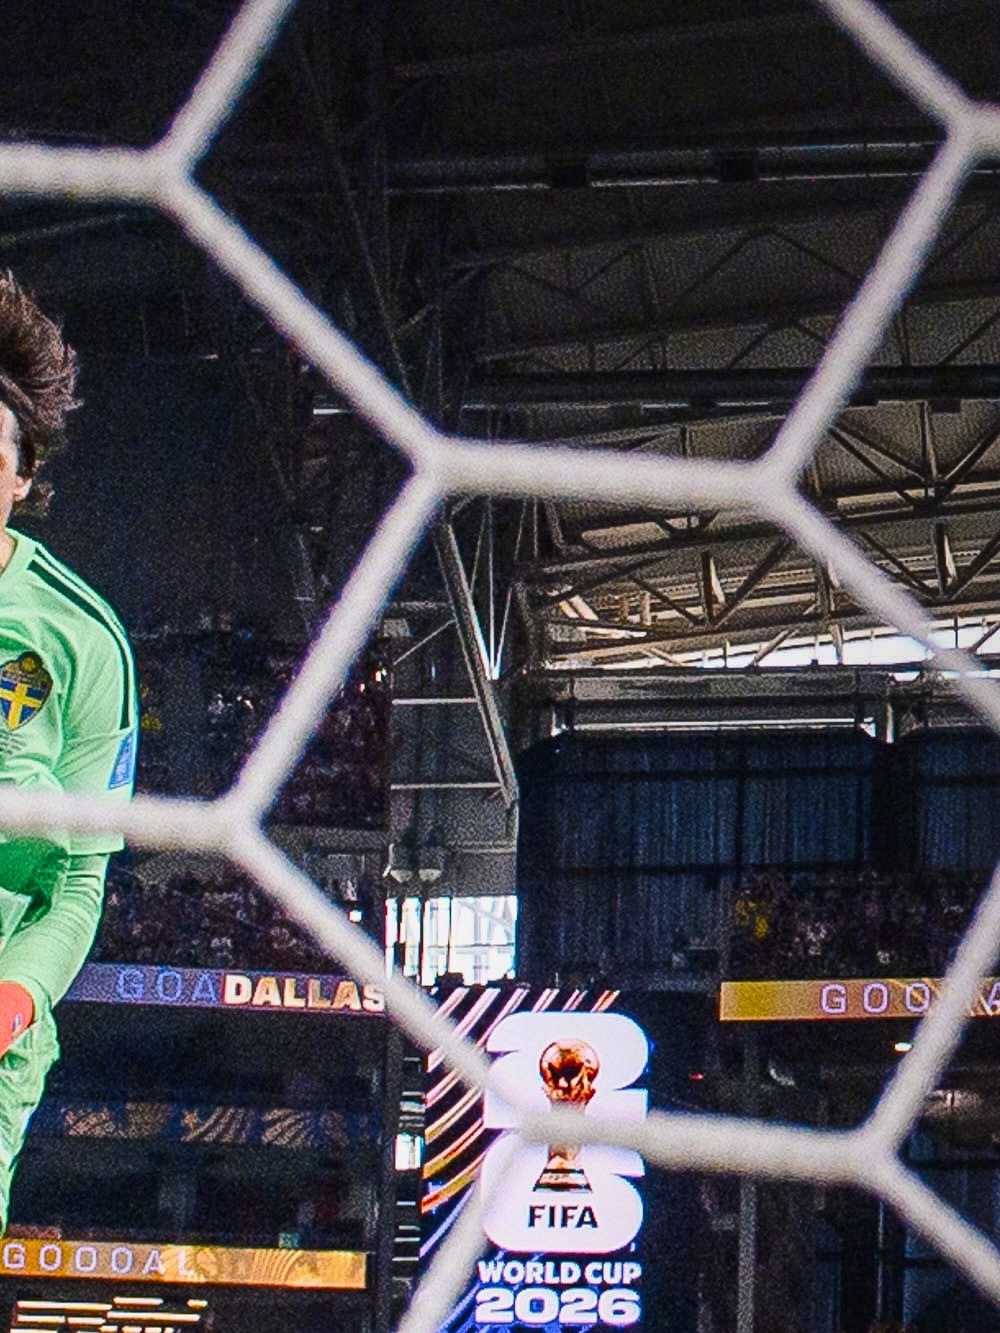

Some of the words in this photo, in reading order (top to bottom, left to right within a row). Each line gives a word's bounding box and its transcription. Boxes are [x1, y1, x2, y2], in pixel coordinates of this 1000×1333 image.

[222, 974, 385, 1013] DALLAS
[820, 981, 1000, 1016] GOO
[528, 1205, 598, 1228] FIFA
[3, 1242, 195, 1277] GOOOAL
[477, 1260, 581, 1285] WORLD
[584, 1261, 642, 1285] CUP
[475, 1287, 642, 1327] 2026
